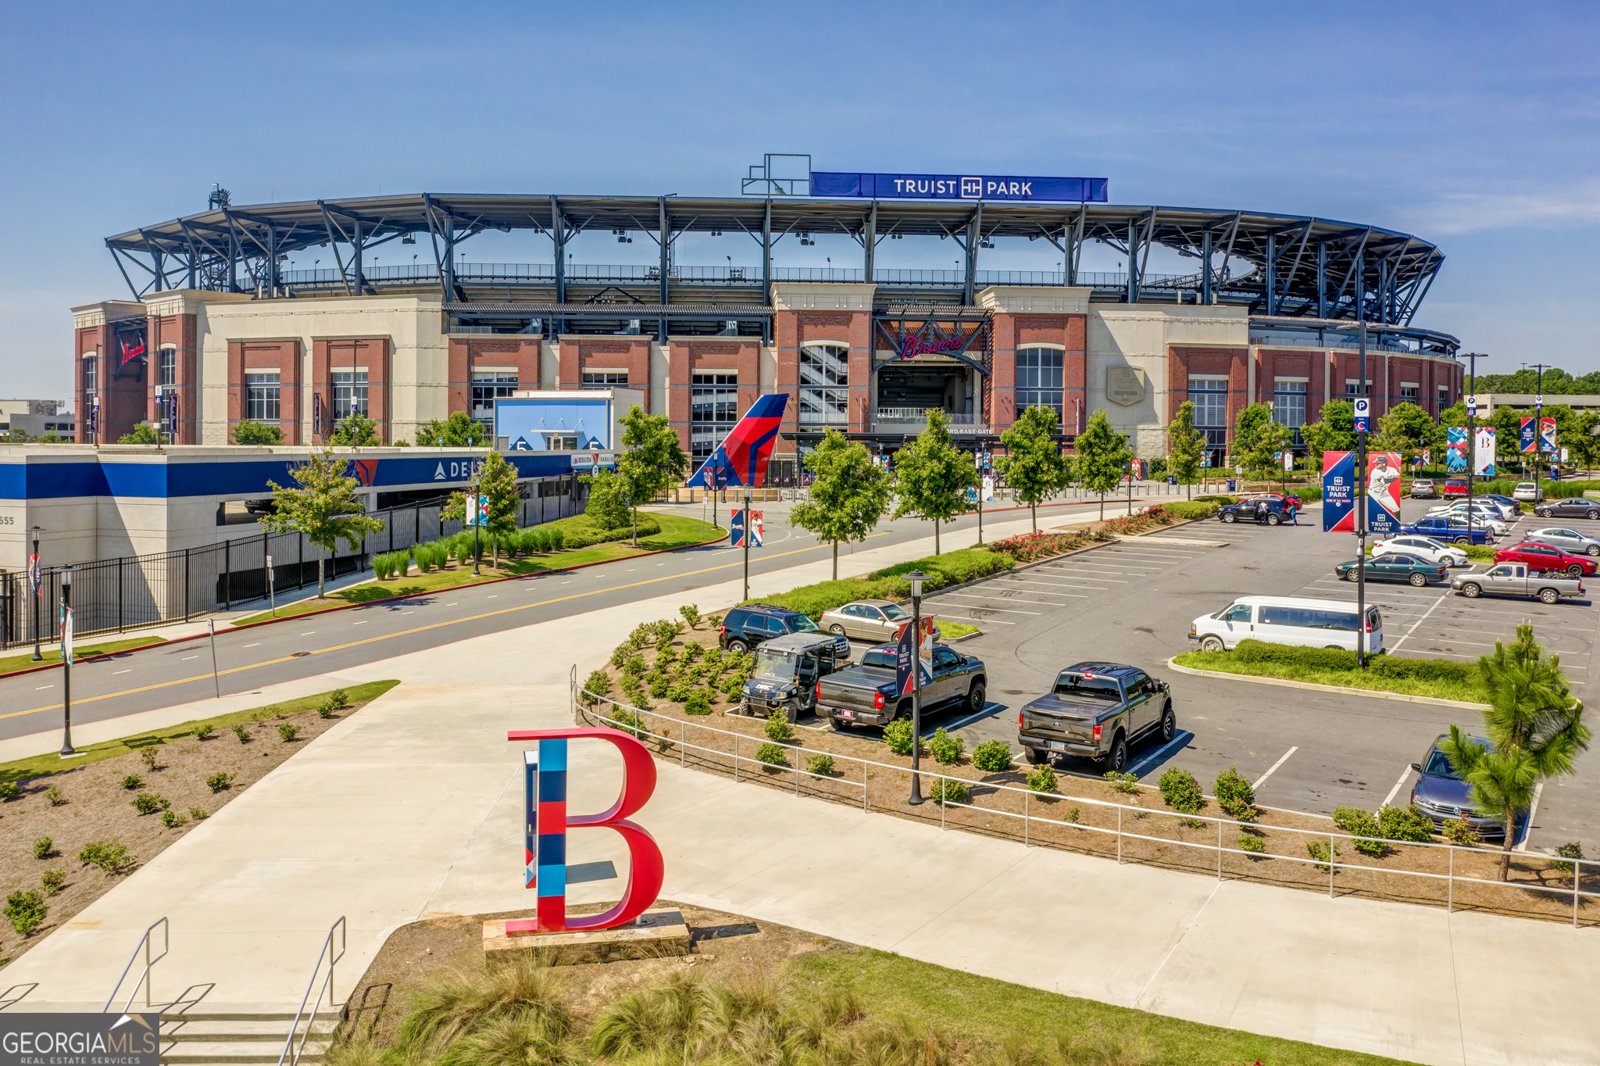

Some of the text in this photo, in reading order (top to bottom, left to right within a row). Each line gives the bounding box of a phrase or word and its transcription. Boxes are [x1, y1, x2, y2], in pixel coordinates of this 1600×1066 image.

[894, 179, 1032, 195] TRUIST PARK
[1358, 402, 1366, 410] P
[1357, 421, 1366, 430] C
[505, 726, 665, 936] B
